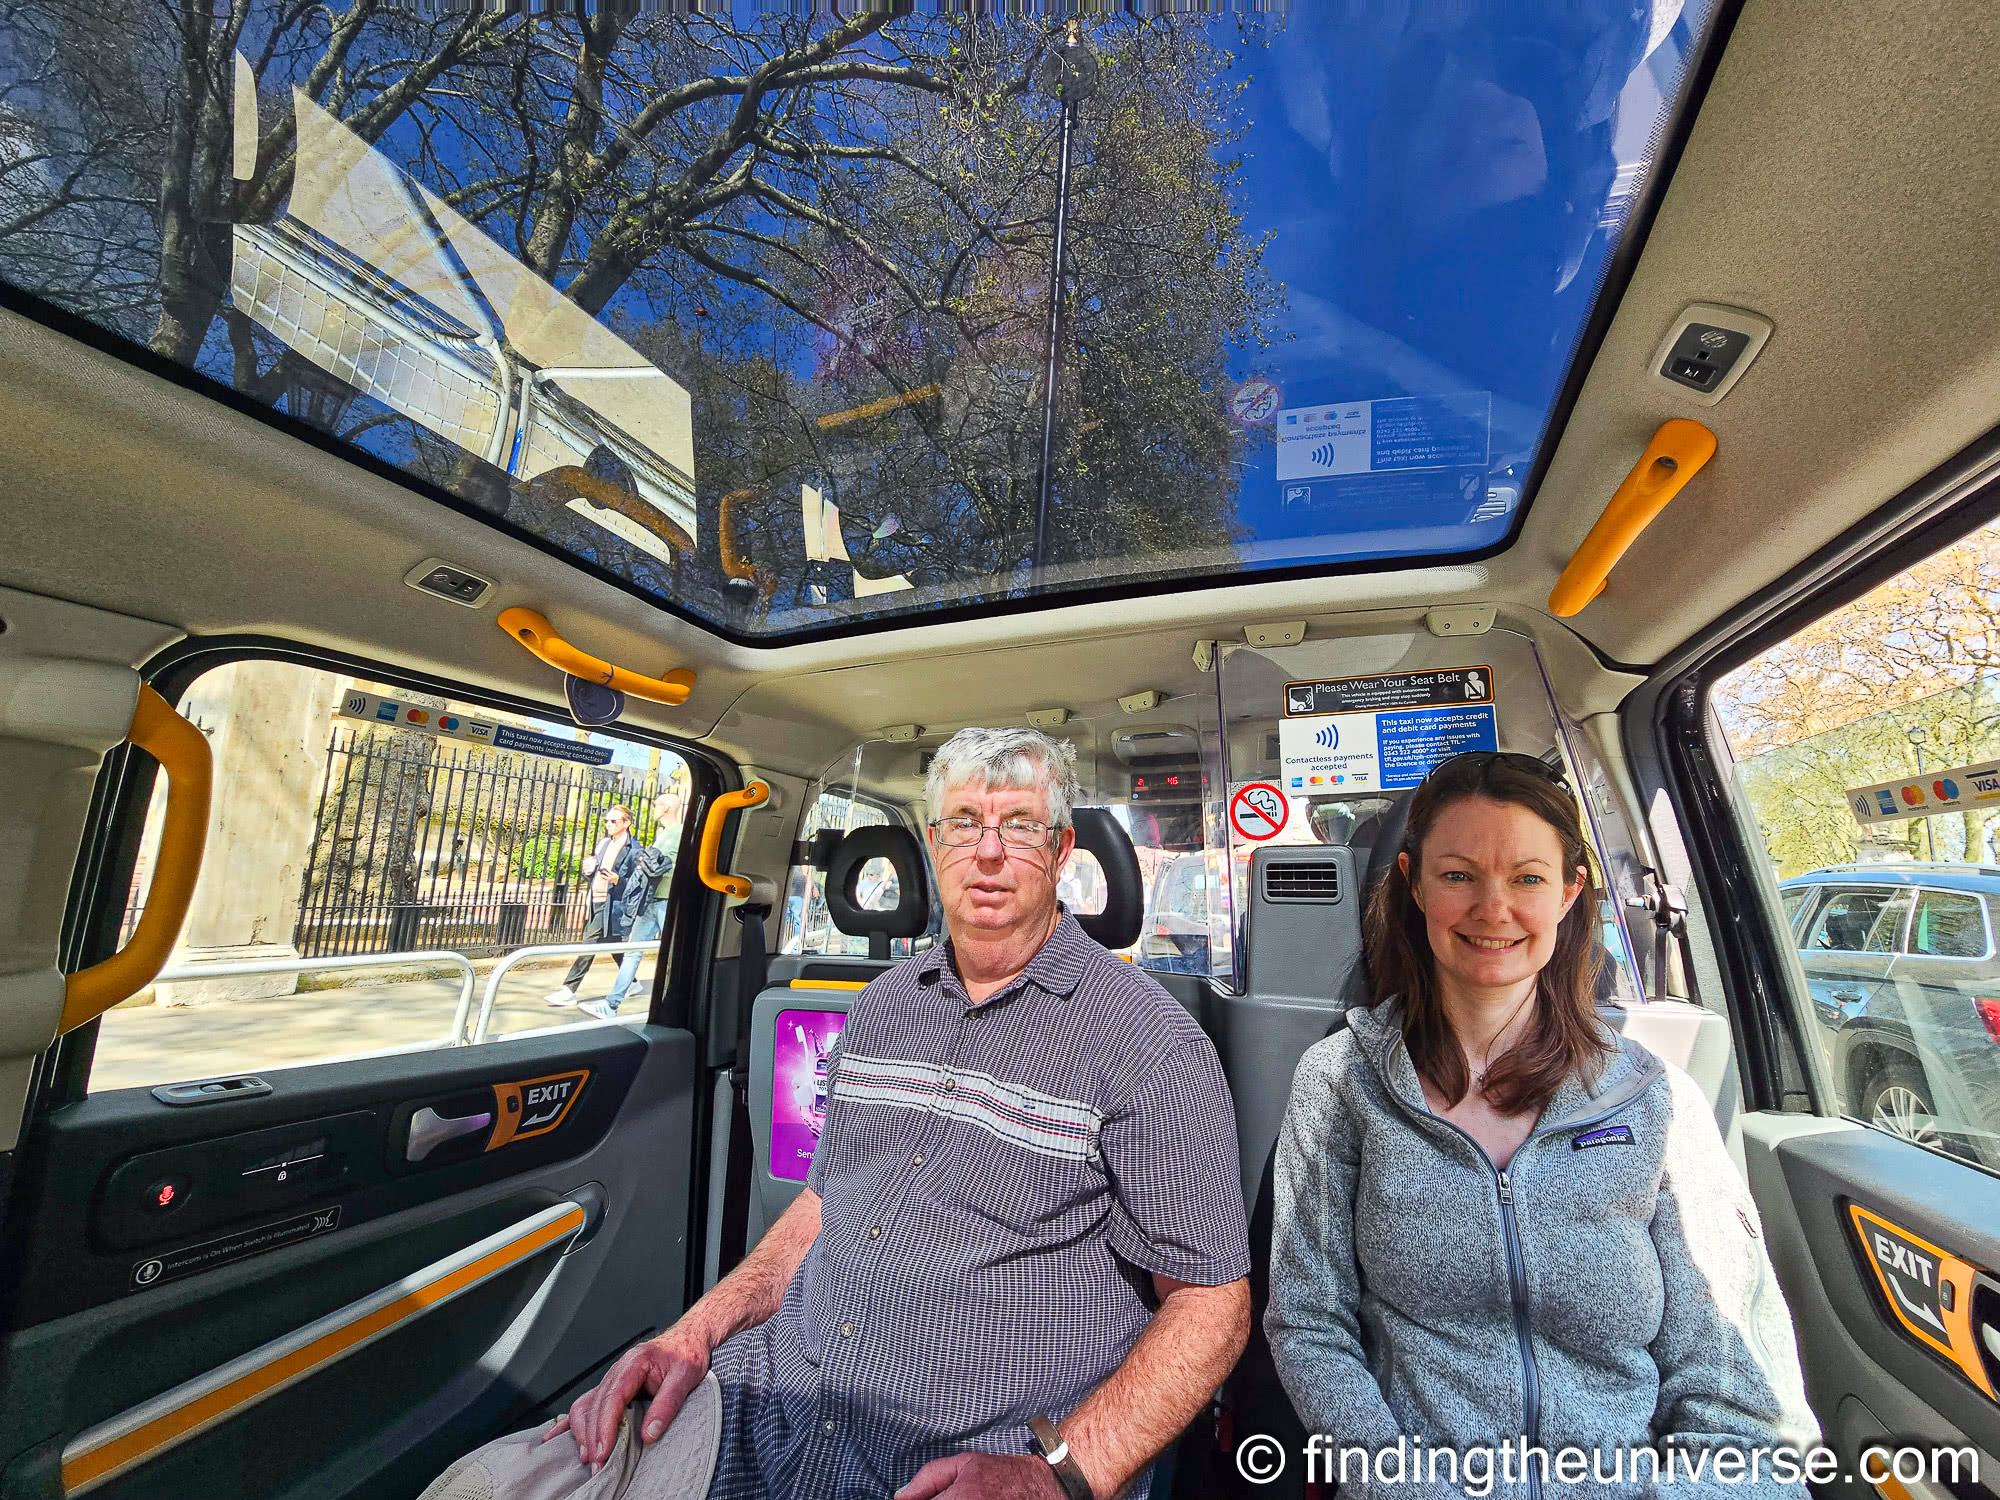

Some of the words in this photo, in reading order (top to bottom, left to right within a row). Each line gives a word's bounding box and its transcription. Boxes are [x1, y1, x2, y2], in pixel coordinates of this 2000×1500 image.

[1315, 683, 1348, 693] Please
[1349, 681, 1379, 690] Wear
[1381, 678, 1407, 687] Your
[1410, 675, 1435, 685] Seat
[1438, 673, 1460, 683] Belt
[1439, 721, 1476, 730] payments
[472, 727, 488, 737] VISA
[501, 729, 515, 738] This
[516, 733, 528, 741] taxi
[543, 740, 566, 750] accepts
[567, 743, 583, 753] credit
[584, 747, 594, 755] and
[594, 750, 609, 758] debit
[499, 738, 513, 746] card
[514, 741, 544, 752] payments
[545, 747, 571, 758] including
[572, 752, 603, 764] contactless
[1286, 756, 1332, 764] Contactless
[1334, 753, 1373, 762] payments
[1311, 763, 1347, 771] accepted
[1972, 778, 2000, 792] VISA
[528, 1082, 571, 1105] EXIT
[1580, 1135, 1626, 1147] patagonia
[167, 1256, 201, 1270] Intercom
[210, 1249, 220, 1257] On
[222, 1243, 243, 1254] When
[244, 1236, 266, 1248] Switch
[1874, 1232, 1933, 1288] EXIT
